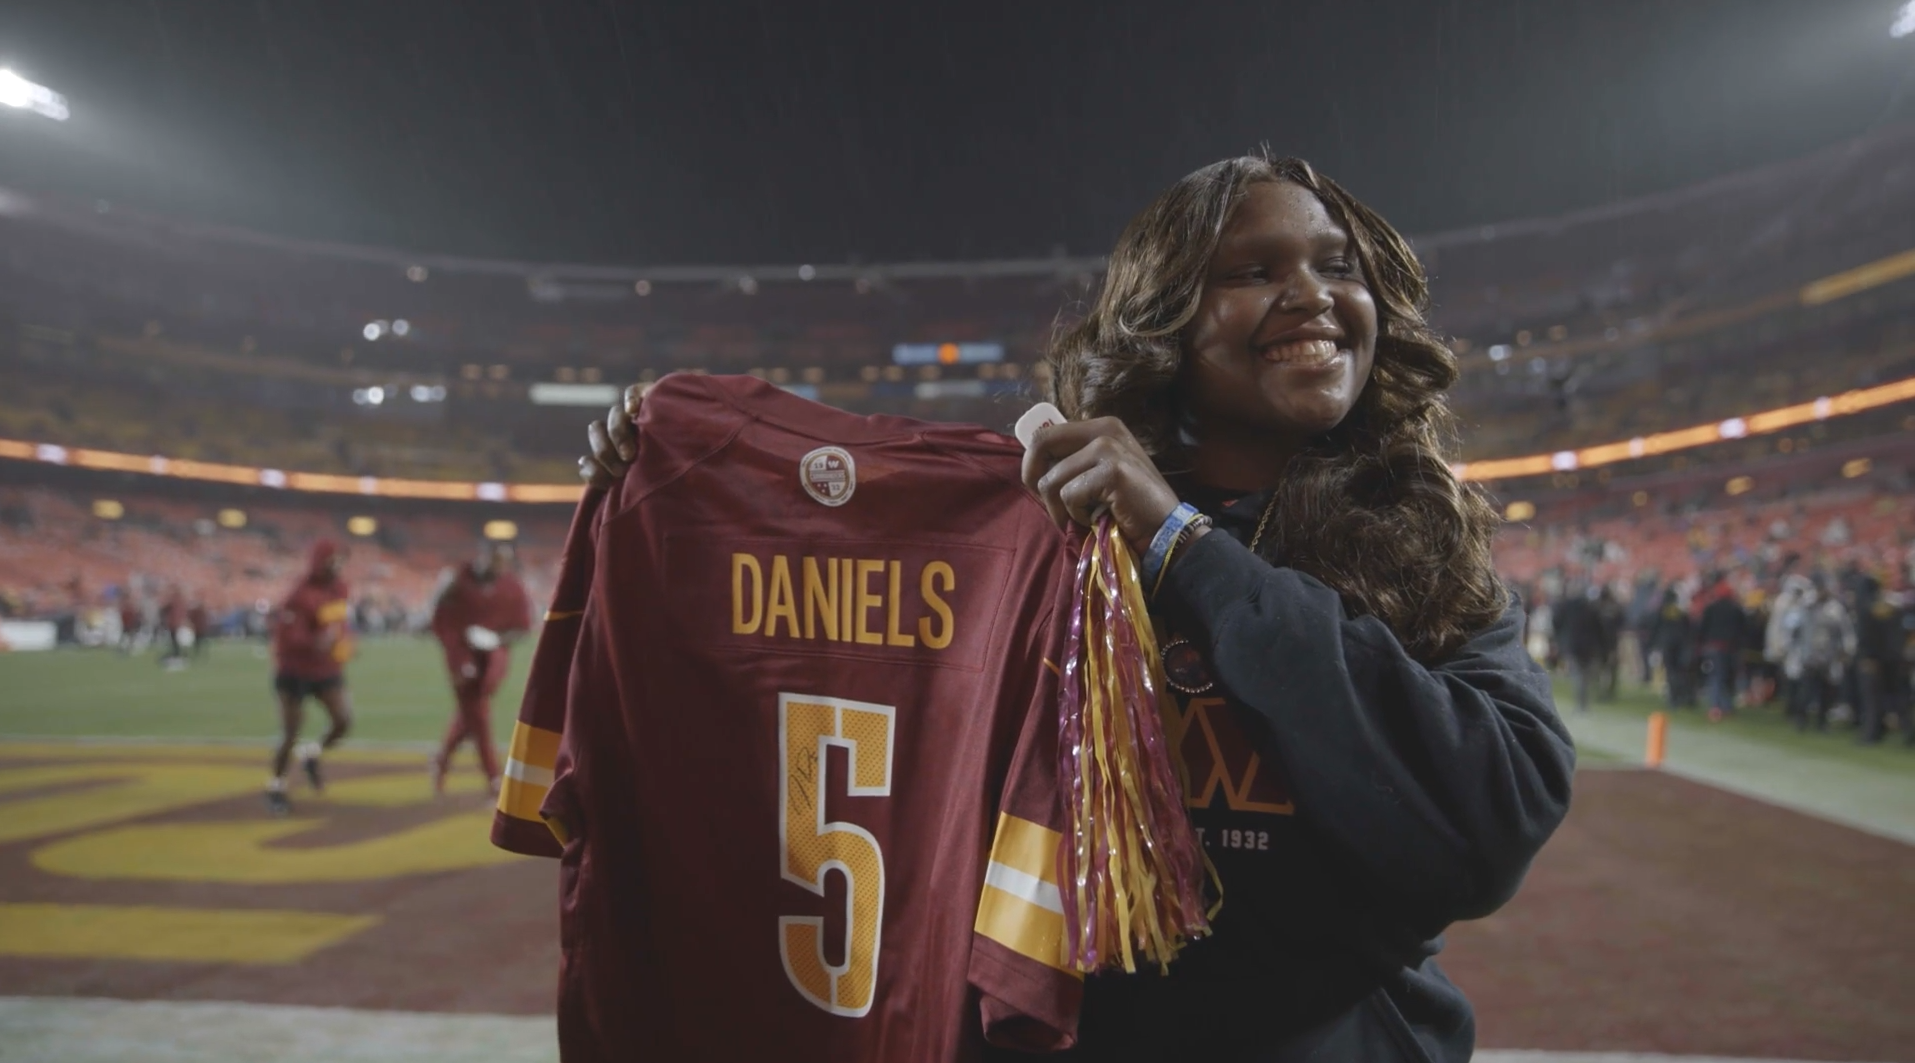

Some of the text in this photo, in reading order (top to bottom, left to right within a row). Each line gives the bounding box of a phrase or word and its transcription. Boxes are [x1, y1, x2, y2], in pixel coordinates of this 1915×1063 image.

[828, 460, 839, 469] W
[732, 553, 955, 649] DANIELS
[778, 692, 896, 1018] 5
[1222, 829, 1269, 850] 1932
